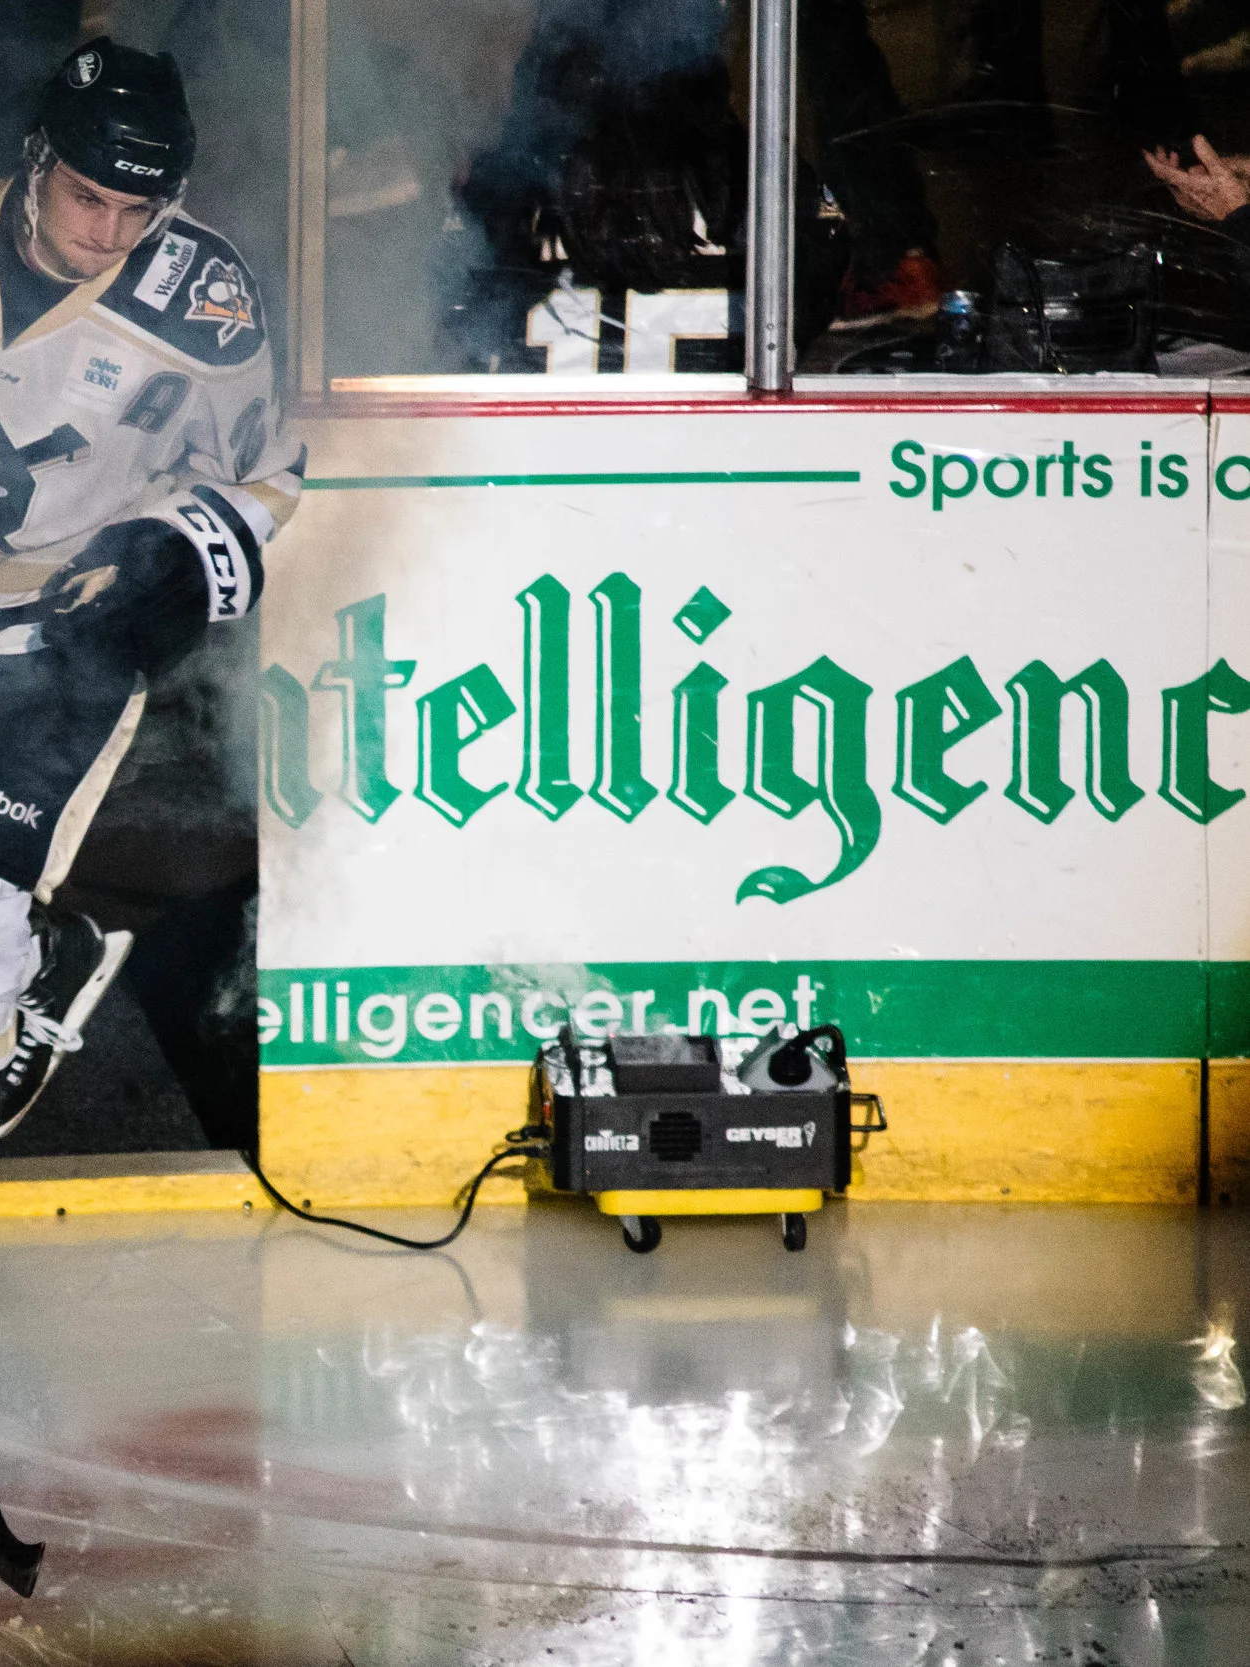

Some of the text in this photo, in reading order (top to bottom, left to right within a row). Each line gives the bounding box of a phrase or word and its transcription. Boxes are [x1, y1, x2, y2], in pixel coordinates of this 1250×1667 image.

[114, 160, 164, 177] CCM
[889, 439, 1113, 512] Sports
[1140, 440, 1189, 499] is
[177, 504, 238, 616] CCM
